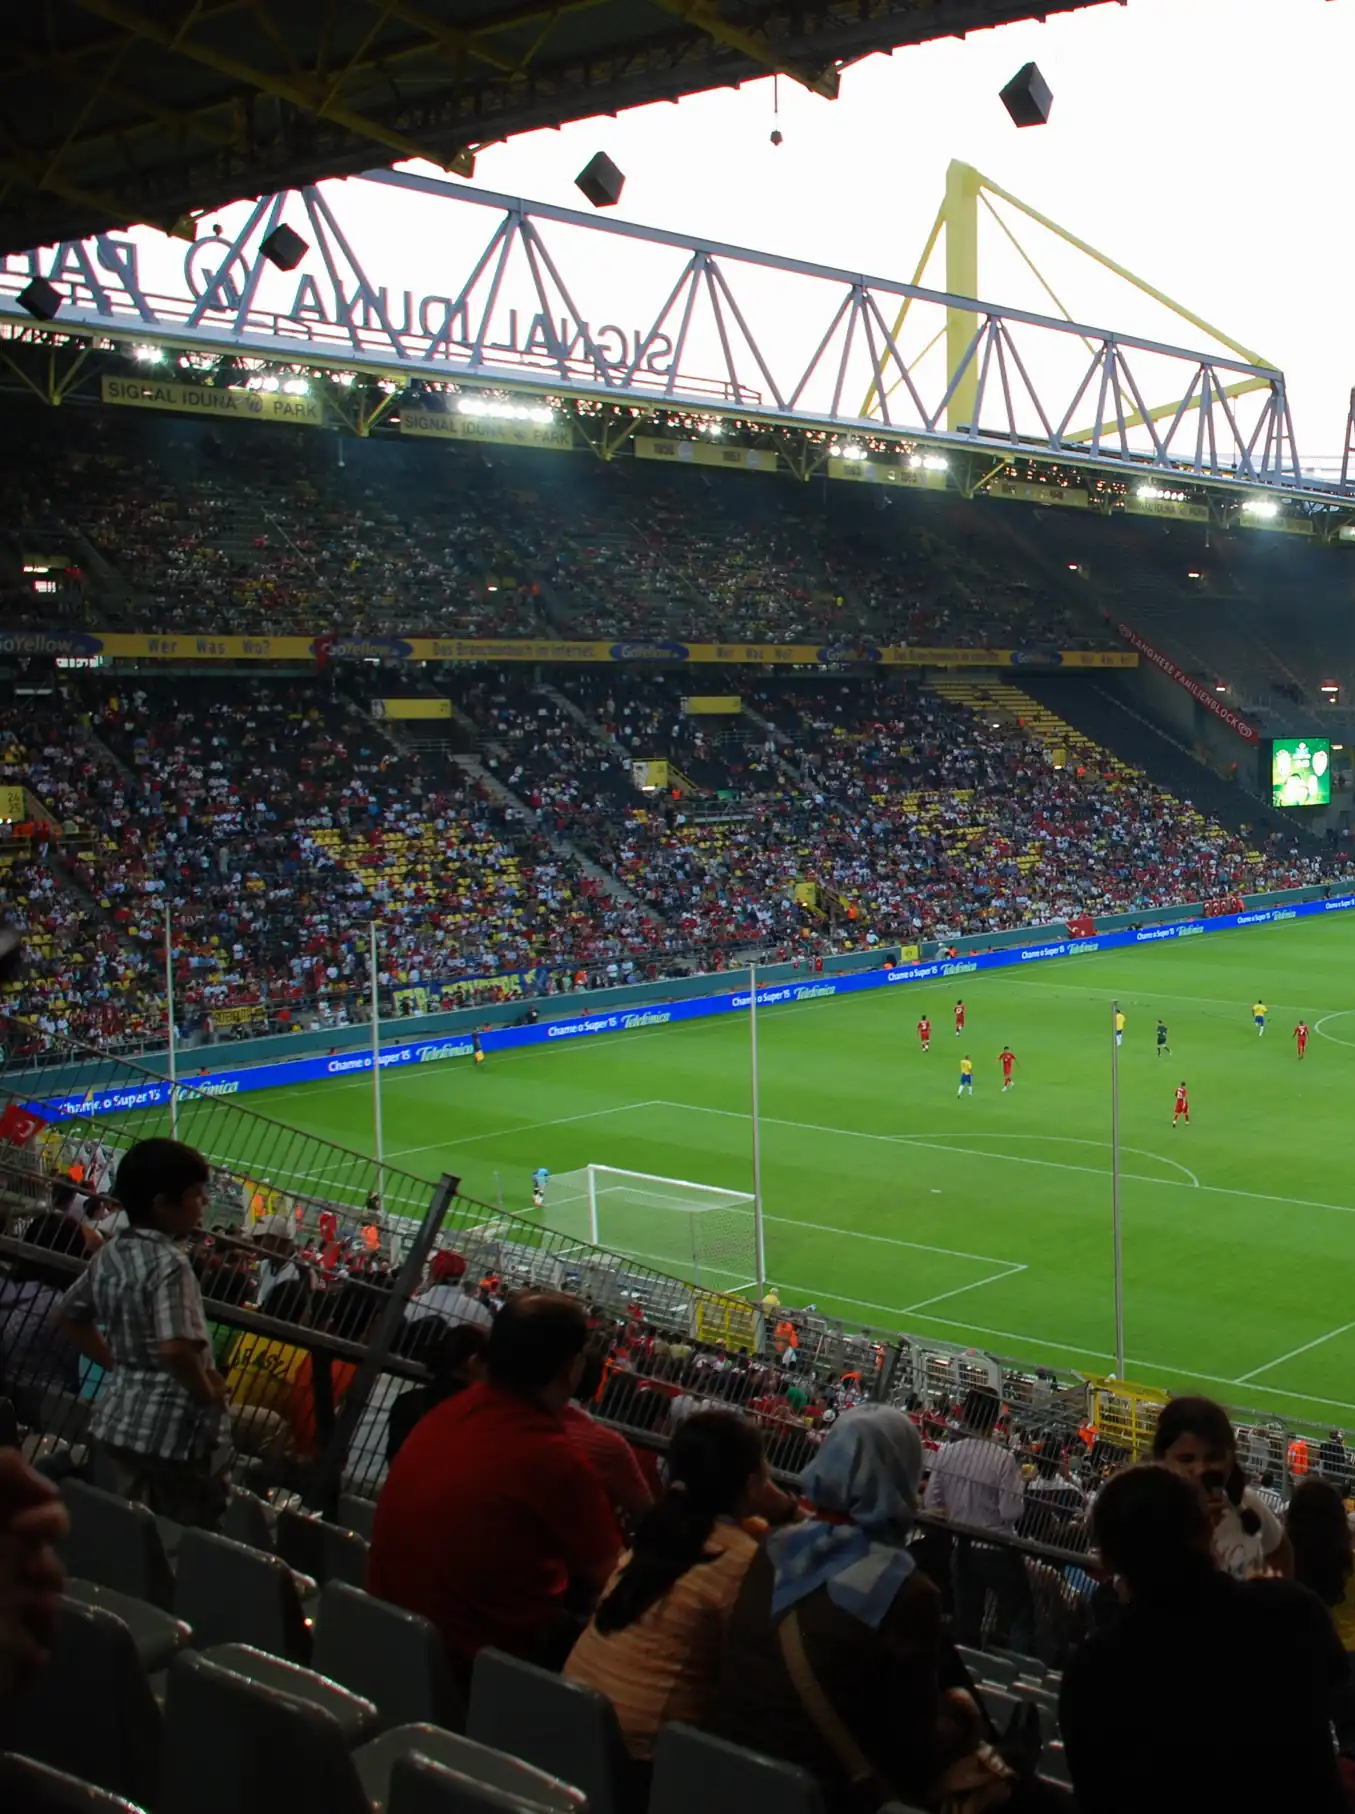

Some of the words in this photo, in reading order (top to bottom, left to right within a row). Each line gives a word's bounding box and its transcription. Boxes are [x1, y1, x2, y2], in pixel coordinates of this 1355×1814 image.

[107, 381, 173, 406] SIGNAL
[182, 388, 237, 411] IDUNA
[273, 400, 318, 419] PARK
[404, 413, 457, 434] SIGNAL
[532, 428, 571, 446] PARK
[147, 640, 178, 654] Wer
[196, 641, 226, 655] Was
[241, 641, 271, 655] Wo?
[763, 992, 784, 1003] Super
[547, 1026, 577, 1036] Chame
[584, 1020, 608, 1032] Super
[328, 1058, 363, 1072] Chame
[113, 1093, 147, 1109] Super
